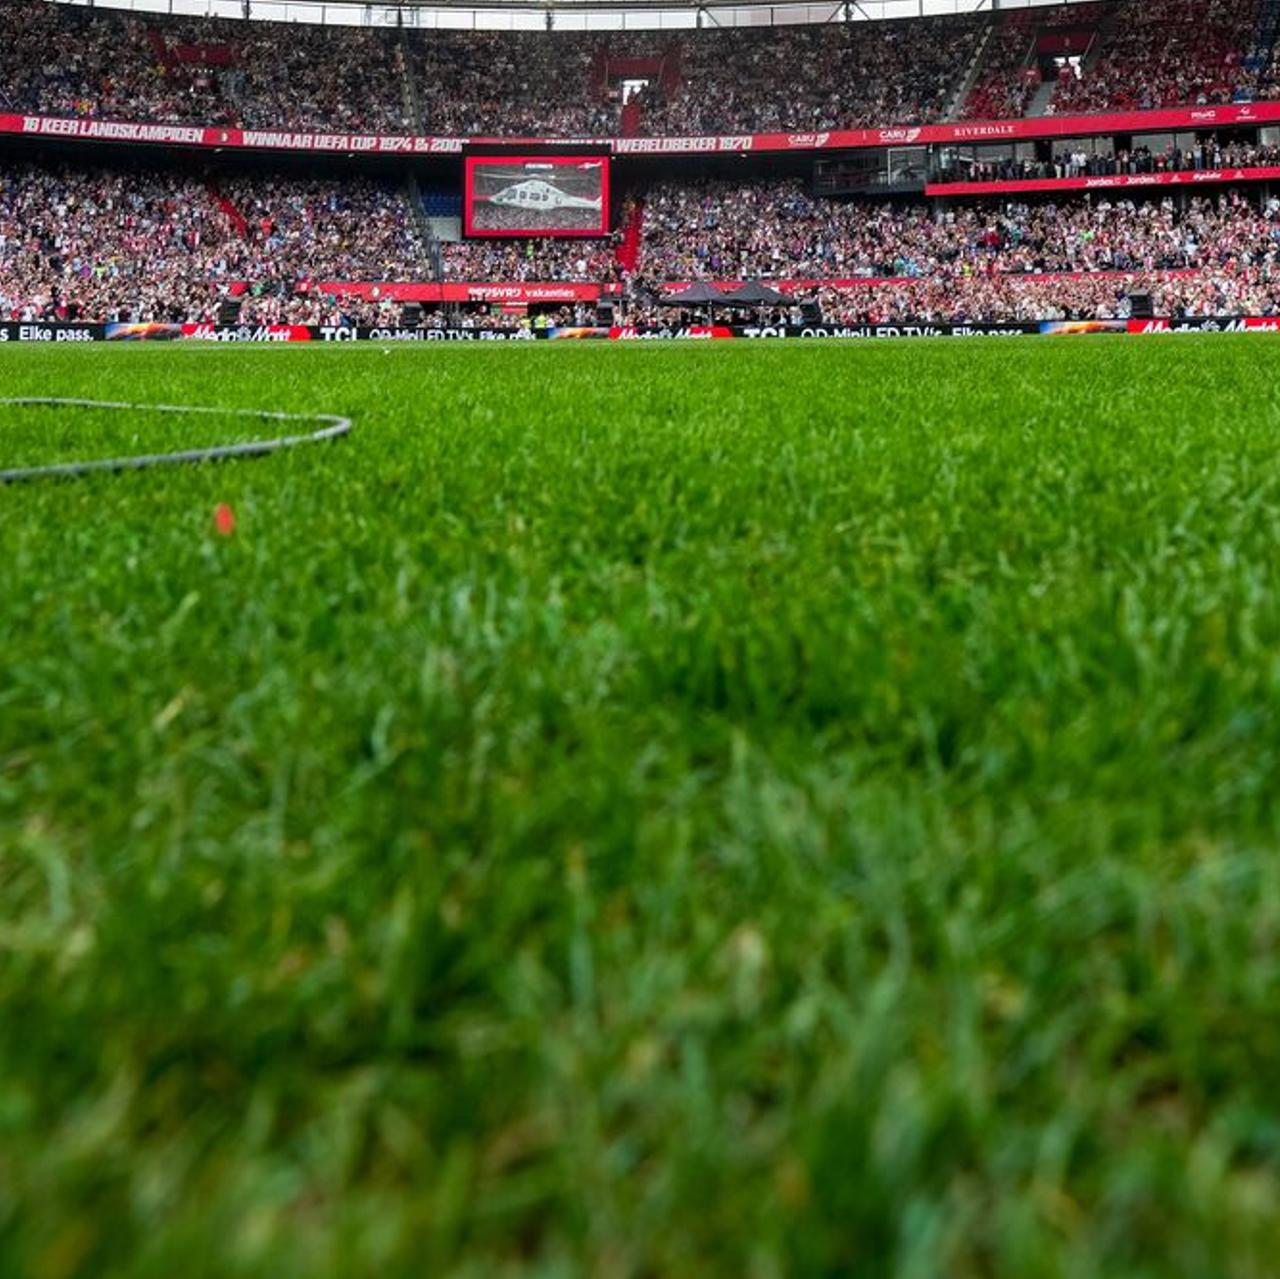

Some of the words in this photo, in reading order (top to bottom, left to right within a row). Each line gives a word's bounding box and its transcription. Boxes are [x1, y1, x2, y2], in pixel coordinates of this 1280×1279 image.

[40, 117, 79, 135] KEER
[80, 120, 204, 143] LANDSKAMPIOEN
[954, 125, 1015, 137] RIVERDALE
[242, 131, 312, 148] WINNAAR
[313, 132, 349, 150] UEFA
[350, 134, 377, 151] CUP
[379, 135, 412, 152] 1974
[616, 137, 716, 152] WERELDBEKER
[718, 135, 753, 150] 1970
[525, 286, 575, 298] vakanties
[20, 325, 54, 341] Elke
[56, 327, 94, 342] pass.
